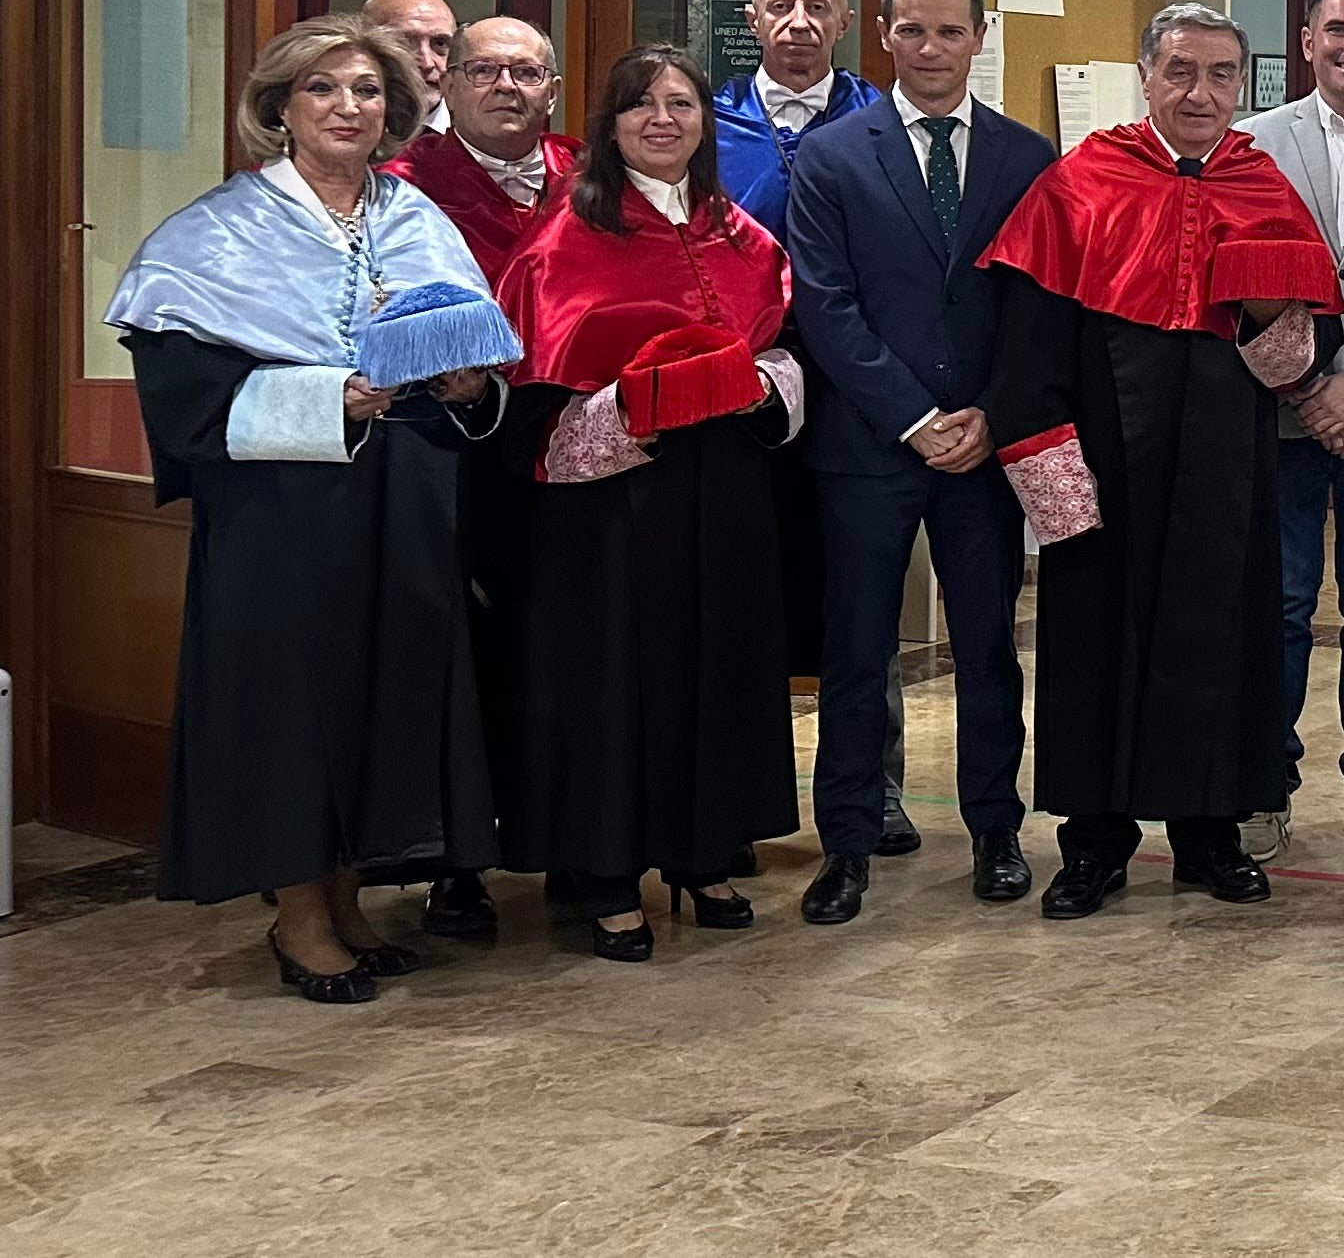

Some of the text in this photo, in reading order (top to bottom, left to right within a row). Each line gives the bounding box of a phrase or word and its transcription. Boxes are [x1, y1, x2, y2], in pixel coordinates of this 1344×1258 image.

[715, 28, 738, 36] UNED
[722, 47, 761, 55] Formación
[731, 57, 758, 65] Cultura
